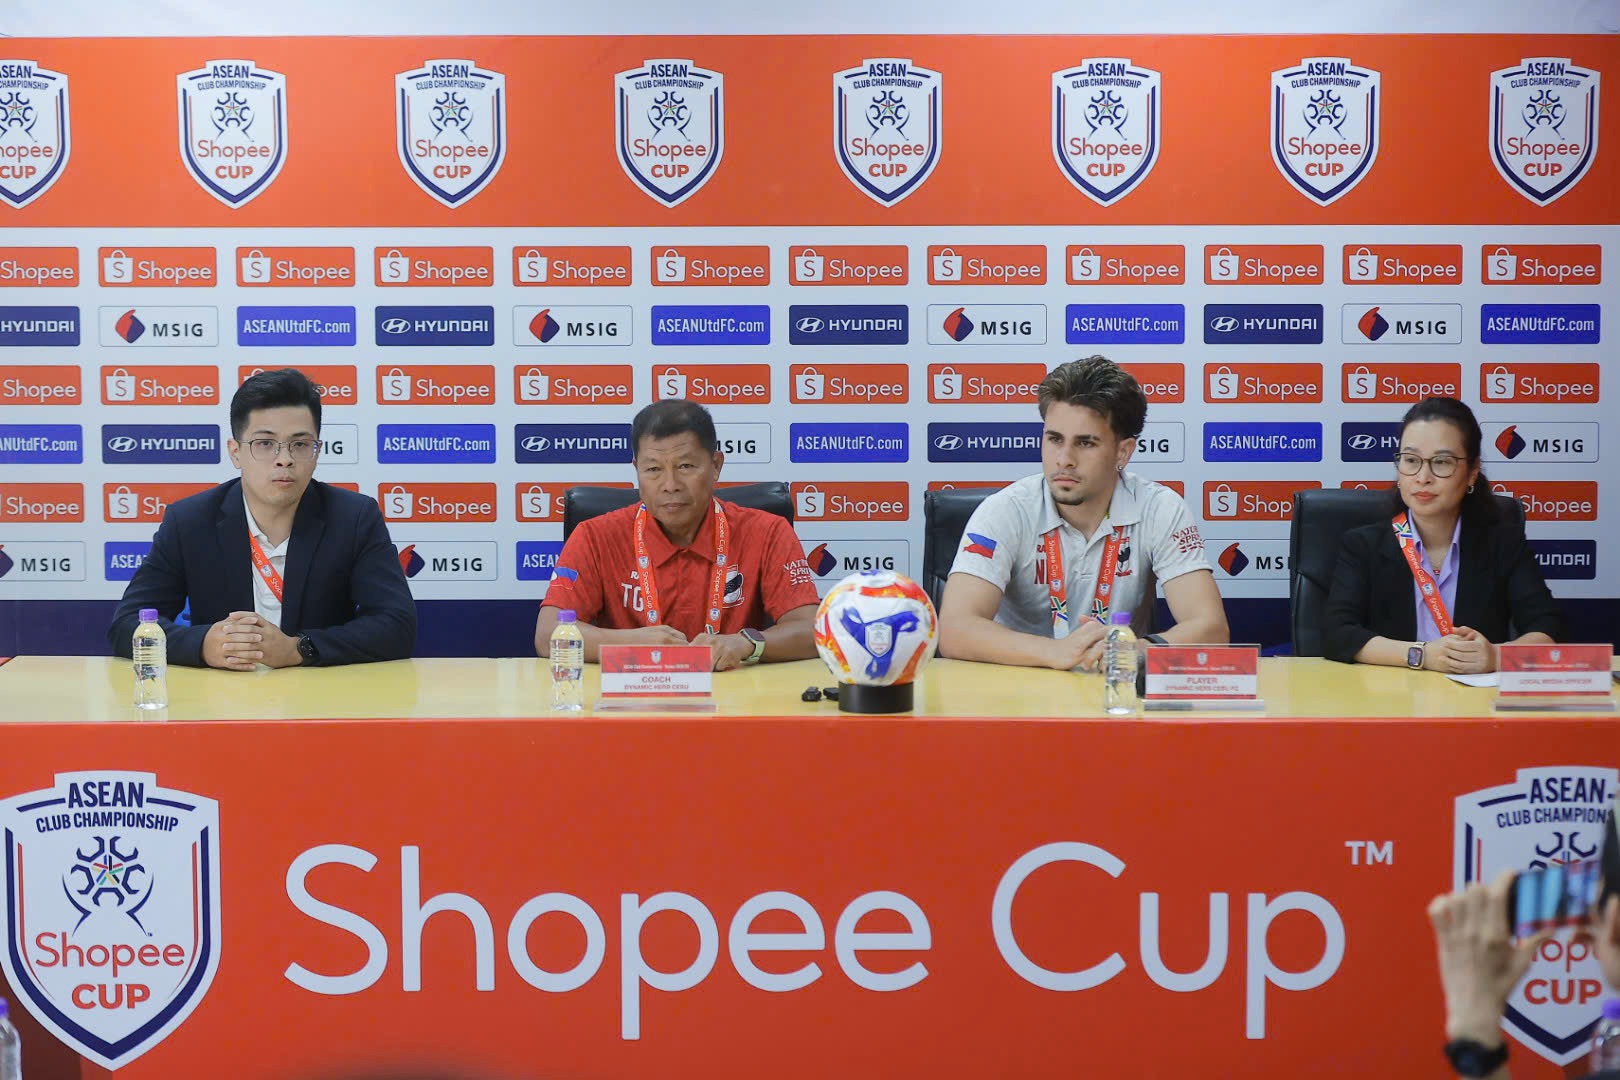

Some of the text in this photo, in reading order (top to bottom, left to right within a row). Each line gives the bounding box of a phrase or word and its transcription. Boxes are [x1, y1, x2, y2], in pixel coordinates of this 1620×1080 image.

[212, 65, 250, 80] ASEAN
[432, 65, 469, 79] ASEAN
[651, 64, 688, 79] ASEAN
[870, 64, 907, 78] ASEAN
[1089, 63, 1126, 78] ASEAN
[1308, 63, 1345, 77] ASEAN
[1527, 62, 1564, 77] ASEAN
[198, 80, 266, 91] CLUB CHAMPIONSHIP
[416, 79, 485, 90] CLUB CHAMPIONSHIP
[635, 78, 704, 90] CLUB CHAMPIONSHIP
[854, 78, 923, 90] CLUB CHAMPIONSHIP
[1073, 78, 1142, 89] CLUB CHAMPIONSHIP
[1292, 77, 1361, 88] CLUB CHAMPIONSHIP
[1511, 76, 1580, 88] CLUB CHAMPIONSHIP
[197, 139, 270, 163] Shopee
[415, 139, 488, 163] Shopee
[634, 138, 707, 162] Shopee
[852, 138, 925, 162] Shopee
[1070, 137, 1143, 161] Shopee
[1288, 137, 1362, 161] Shopee
[1507, 136, 1580, 160] Shopee
[0, 166, 37, 179] CUP
[215, 166, 254, 180] CUP
[433, 165, 472, 179] CUP
[651, 165, 690, 179] CUP
[869, 164, 908, 178] CUP
[1087, 164, 1126, 178] CUP
[1306, 163, 1344, 177] CUP
[1524, 163, 1562, 177] CUP
[0, 261, 73, 284] Shopee
[138, 261, 212, 284] Shopee
[276, 261, 350, 284] Shopee
[414, 260, 488, 283] Shopee
[553, 260, 626, 283] Shopee
[691, 260, 764, 283] Shopee
[830, 260, 902, 283] Shopee
[967, 259, 1040, 282] Shopee
[1106, 259, 1179, 282] Shopee
[1245, 259, 1318, 282] Shopee
[1384, 259, 1457, 282] Shopee
[1522, 259, 1596, 282] Shopee
[1, 321, 74, 332] HYUNDAI
[153, 323, 203, 337] MSIG
[243, 320, 350, 333] ASEANUtdFC.com
[414, 320, 488, 331] HYUNDAI
[567, 323, 617, 336] MSIG
[658, 319, 764, 332] ASEANUtdFC.com
[829, 320, 902, 331] HYUNDAI
[981, 322, 1032, 335] MSIG
[1072, 318, 1179, 332] ASEANUtdFC.com
[1243, 319, 1317, 330] HYUNDAI
[1396, 321, 1447, 335] MSIG
[1487, 318, 1594, 331] ASEANUtdFC.com
[3, 379, 76, 402] Shopee
[140, 379, 214, 402] Shopee
[416, 379, 489, 402] Shopee
[554, 378, 627, 401] Shopee
[692, 378, 765, 401] Shopee
[830, 378, 902, 401] Shopee
[968, 378, 1040, 400] Shopee
[1142, 384, 1179, 396] pee
[1244, 377, 1317, 400] Shopee
[1382, 377, 1455, 400] Shopee
[1521, 377, 1594, 400] Shopee
[141, 438, 215, 450] HYUNDAI
[324, 441, 343, 454] IG
[384, 437, 490, 450] ASEANUtdFC.com
[555, 438, 627, 450] HYUNDAI
[797, 436, 902, 450] ASEANUtdFC.com
[968, 437, 1040, 448] HYUNDAI
[1138, 440, 1169, 452] SIG
[1210, 436, 1316, 450] ASEANUtdFC.com
[1534, 438, 1584, 452] MSIG
[6, 496, 79, 519] Shopee
[418, 496, 492, 519] Shopee
[830, 495, 903, 518] Shopee
[1244, 495, 1292, 518] Shop
[1522, 495, 1592, 518] Shopee
[21, 558, 70, 571] MSIG
[432, 557, 482, 571] MSIG
[844, 557, 894, 570] MSIG
[1534, 554, 1590, 566] UNDAI
[642, 676, 671, 684] COACH
[68, 782, 144, 808] ASEAN
[1530, 778, 1605, 804] ASEAN
[36, 812, 178, 833] CLUB CHAMPIONSHIP
[1497, 807, 1608, 828] CLUB CHAMPION
[284, 840, 1394, 1040] Shopee Cup TM
[35, 932, 185, 978] Shopee
[72, 984, 150, 1010] CUP
[1524, 978, 1602, 1005] CUP
